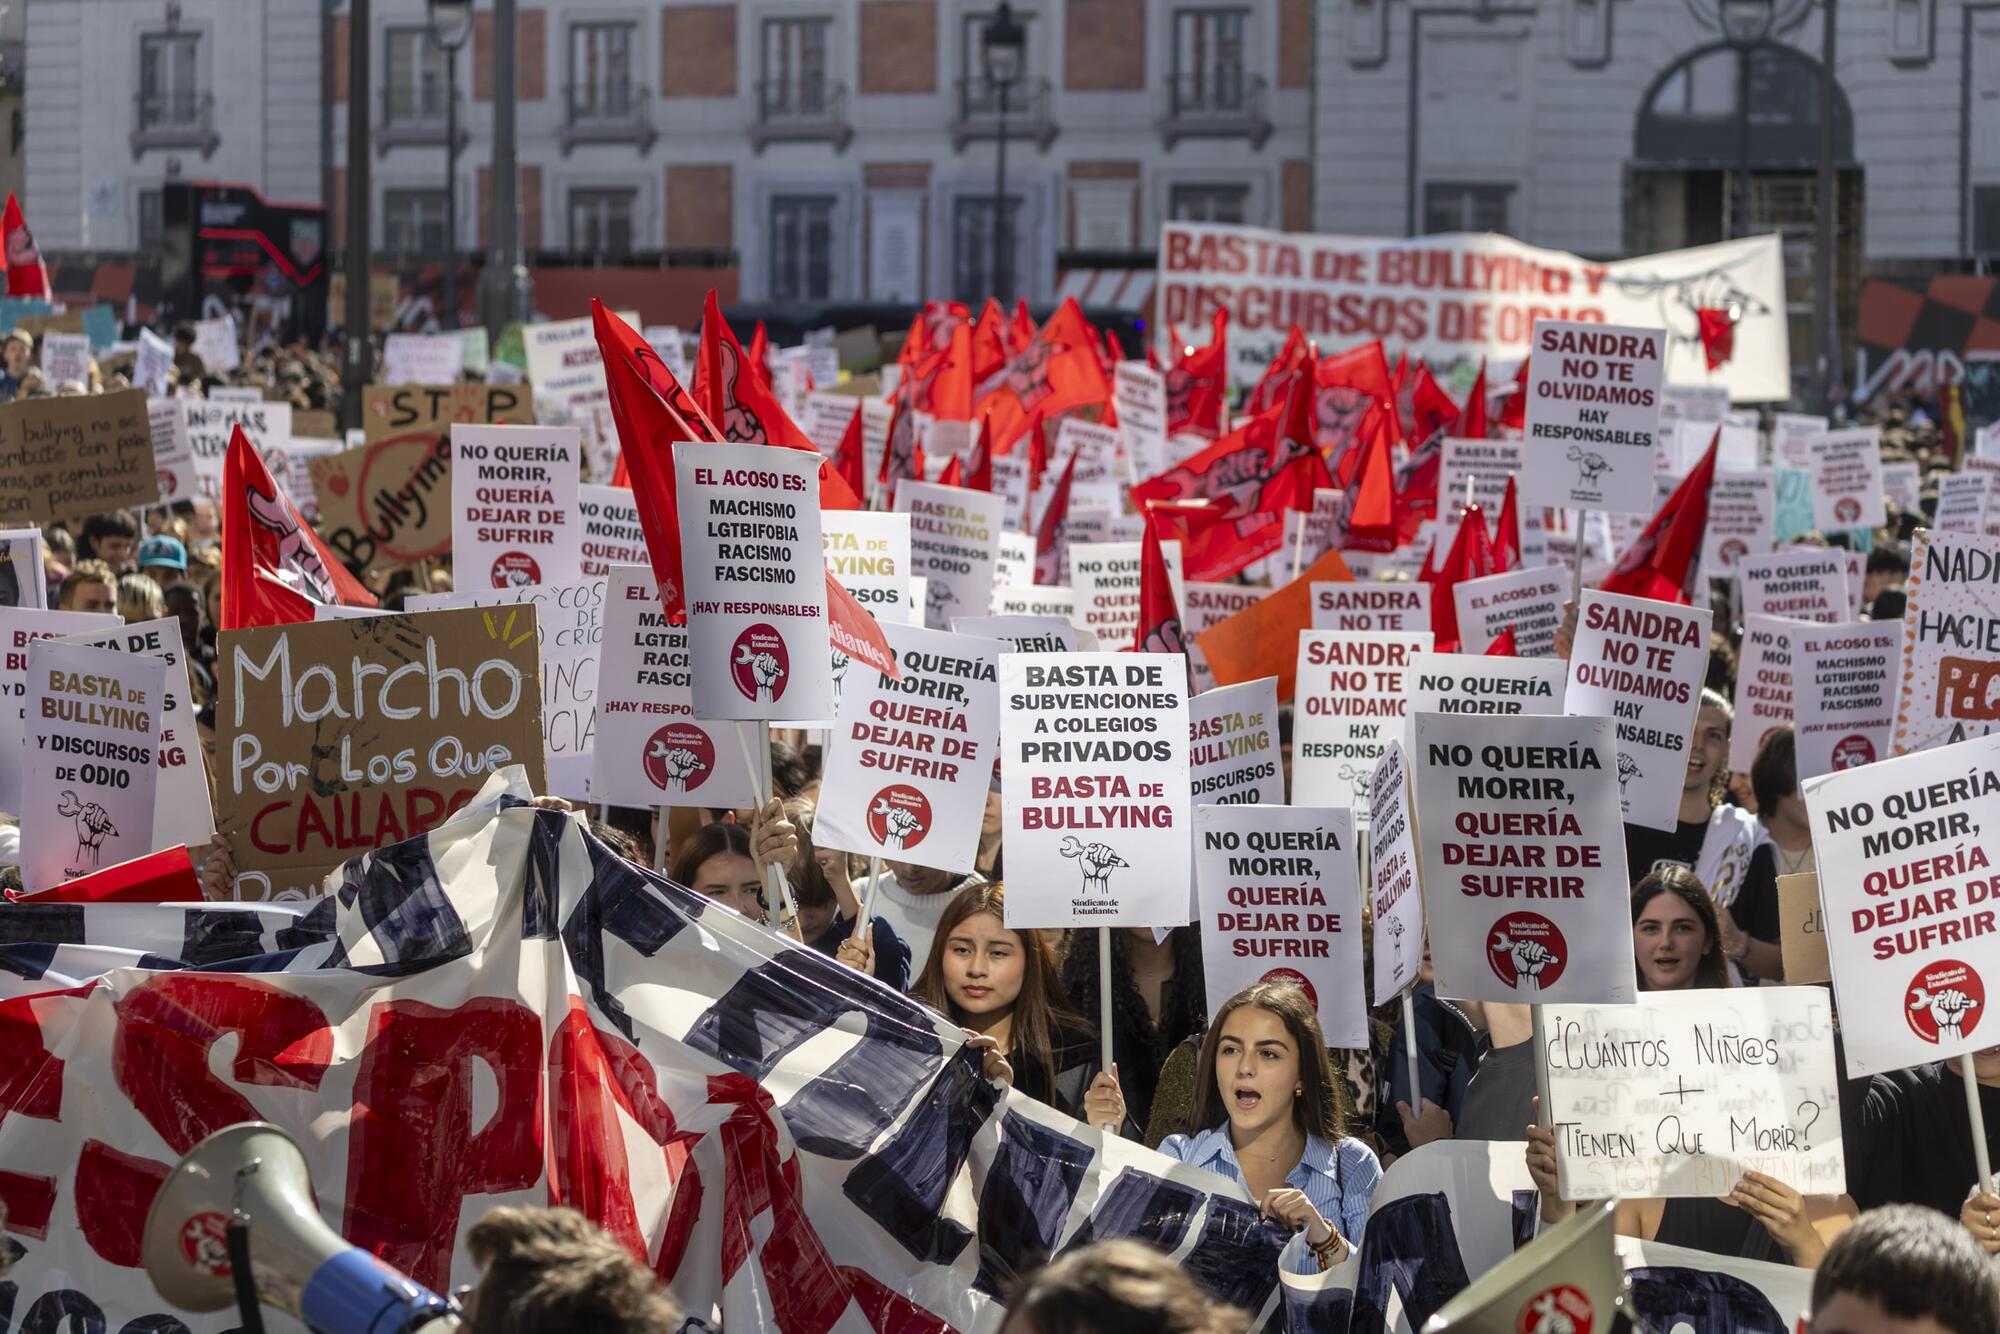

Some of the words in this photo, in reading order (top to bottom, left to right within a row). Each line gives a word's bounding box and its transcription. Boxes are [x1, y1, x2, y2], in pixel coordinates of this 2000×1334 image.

[1166, 231, 1303, 281] BASTA
[1311, 246, 1369, 286] DE
[1376, 249, 1572, 294] BULLYING
[1582, 266, 1609, 294] Y
[1165, 283, 1429, 343] DISCURSOS
[1437, 301, 1489, 343] DE
[1541, 329, 1657, 360] SANDRA
[1562, 359, 1598, 379] NO
[1605, 361, 1634, 382] TE
[1537, 380, 1654, 407] OLVIDAMOS
[1579, 408, 1609, 424] HAY
[1532, 423, 1652, 447] RESPONSABLES
[460, 444, 491, 460] NO
[494, 443, 570, 462] QUERÍA
[1454, 447, 1497, 458] BASTA
[1501, 447, 1519, 458] DE
[478, 466, 552, 484] MORIR,
[694, 468, 718, 485] EL
[722, 469, 779, 489] ACOSO
[782, 474, 807, 491] ES:
[475, 486, 555, 504] QUERÍA
[466, 507, 531, 525] DEJAR
[538, 509, 565, 525] DE
[580, 501, 599, 517] NO
[709, 499, 796, 519] MACHISMO
[911, 499, 967, 519] BASTA
[477, 526, 554, 544] SUFRIR
[707, 521, 799, 542] LGTBIFOBIA
[718, 543, 792, 563] RACISMO
[866, 540, 887, 551] DE
[714, 565, 796, 584] FASCISMO
[928, 557, 971, 575] ODIO
[1078, 562, 1103, 573] NO
[1748, 568, 1771, 579] NO
[1776, 561, 1838, 578] QUERÍA
[625, 585, 650, 600] EL
[1470, 598, 1488, 609] EL
[1492, 586, 1537, 604] ACOSO
[1765, 580, 1825, 594] MORIR,
[692, 601, 720, 615] ¡HAY
[723, 602, 821, 617] RESPONSABLES!
[1004, 601, 1026, 612] NO
[1319, 592, 1421, 610] SANDRA
[1763, 597, 1829, 613] QUERÍA
[1340, 614, 1371, 630] NO
[1378, 614, 1402, 630] TE
[1485, 602, 1556, 625] MACHISMO
[1585, 602, 1701, 648] SANDRA
[128, 632, 161, 653] DE
[1751, 632, 1773, 645] NO
[1805, 641, 1820, 652] EL
[1824, 637, 1870, 650] ACOSO
[1874, 637, 1894, 648] ES:
[1601, 638, 1639, 666] NO
[1646, 646, 1675, 673] TE
[1817, 656, 1886, 669] MACHISMO
[903, 651, 997, 683] QUERÍA
[1026, 665, 1118, 687] BASTA
[1125, 666, 1163, 686] DE
[1815, 670, 1886, 684] LGTBIFOBIA
[49, 670, 122, 700] BASTA
[128, 689, 146, 705] DE
[233, 631, 522, 728] Marcho
[878, 672, 970, 707] MORIR,
[1330, 671, 1367, 692] NO
[1374, 672, 1402, 692] TE
[1419, 675, 1454, 692] NO
[1460, 675, 1553, 696] QUERÍA
[1576, 663, 1690, 704] OLVIDAMOS
[1823, 683, 1880, 697] RACISMO
[605, 701, 637, 713] ¡HAY
[1010, 693, 1178, 711] SUBVENCIONES
[1613, 700, 1643, 721] HAY
[1820, 697, 1883, 711] FASCISMO
[41, 697, 150, 733] BULLYING
[869, 699, 968, 733] QUERÍA
[1034, 718, 1048, 734] A
[1054, 717, 1157, 733] COLEGIOS
[1248, 713, 1264, 727] DE
[1349, 724, 1380, 739] HAY
[1802, 722, 1823, 734] ¡HAY
[37, 735, 47, 749] Y
[51, 734, 150, 765] DISCURSOS
[851, 721, 936, 753] DEJAR
[941, 737, 979, 760] DE
[1021, 740, 1171, 763] PRIVADOS
[232, 733, 309, 794] Por
[341, 734, 417, 784] Los
[428, 735, 512, 779] Que
[859, 749, 959, 783] SUFRIR
[1389, 750, 1399, 773] DE
[1429, 744, 1472, 767] NO
[1481, 740, 1601, 770] QUERÍA
[55, 767, 76, 781] DE
[80, 763, 130, 789] ODIO
[1031, 775, 1130, 799] BASTA
[1139, 783, 1164, 798] DE
[1191, 762, 1275, 796] DISCURSOS
[1458, 776, 1575, 805] MORIR,
[1825, 802, 1874, 834] NO
[1882, 767, 2000, 820] QUERÍA
[1022, 804, 1173, 830] BULLYING
[1455, 807, 1583, 838] QUERÍA
[1205, 831, 1240, 850] NO
[1247, 827, 1341, 853] QUERÍA
[1374, 814, 1405, 864] PRIVADOS
[1862, 811, 1980, 859] MORIR,
[1442, 843, 1545, 867] DEJAR
[1556, 845, 1601, 868] DE
[1229, 857, 1321, 880] MORIR,
[1377, 860, 1398, 891] BASTA
[1399, 851, 1407, 867] DE
[1863, 842, 1990, 896] QUERÍA
[1227, 882, 1327, 908] QUERÍA
[1376, 869, 1412, 920] BULLYING
[1460, 874, 1585, 899] SUFRIR
[1071, 898, 1108, 907] Sindicato
[1109, 898, 1119, 907] de
[1072, 906, 1119, 916] Estudiantes
[1852, 888, 1957, 933] DEJAR
[1217, 912, 1300, 932] DEJAR
[1307, 914, 1341, 933] DE
[1872, 911, 1996, 960] SUFRIR
[1232, 938, 1330, 958] SUFRIR
